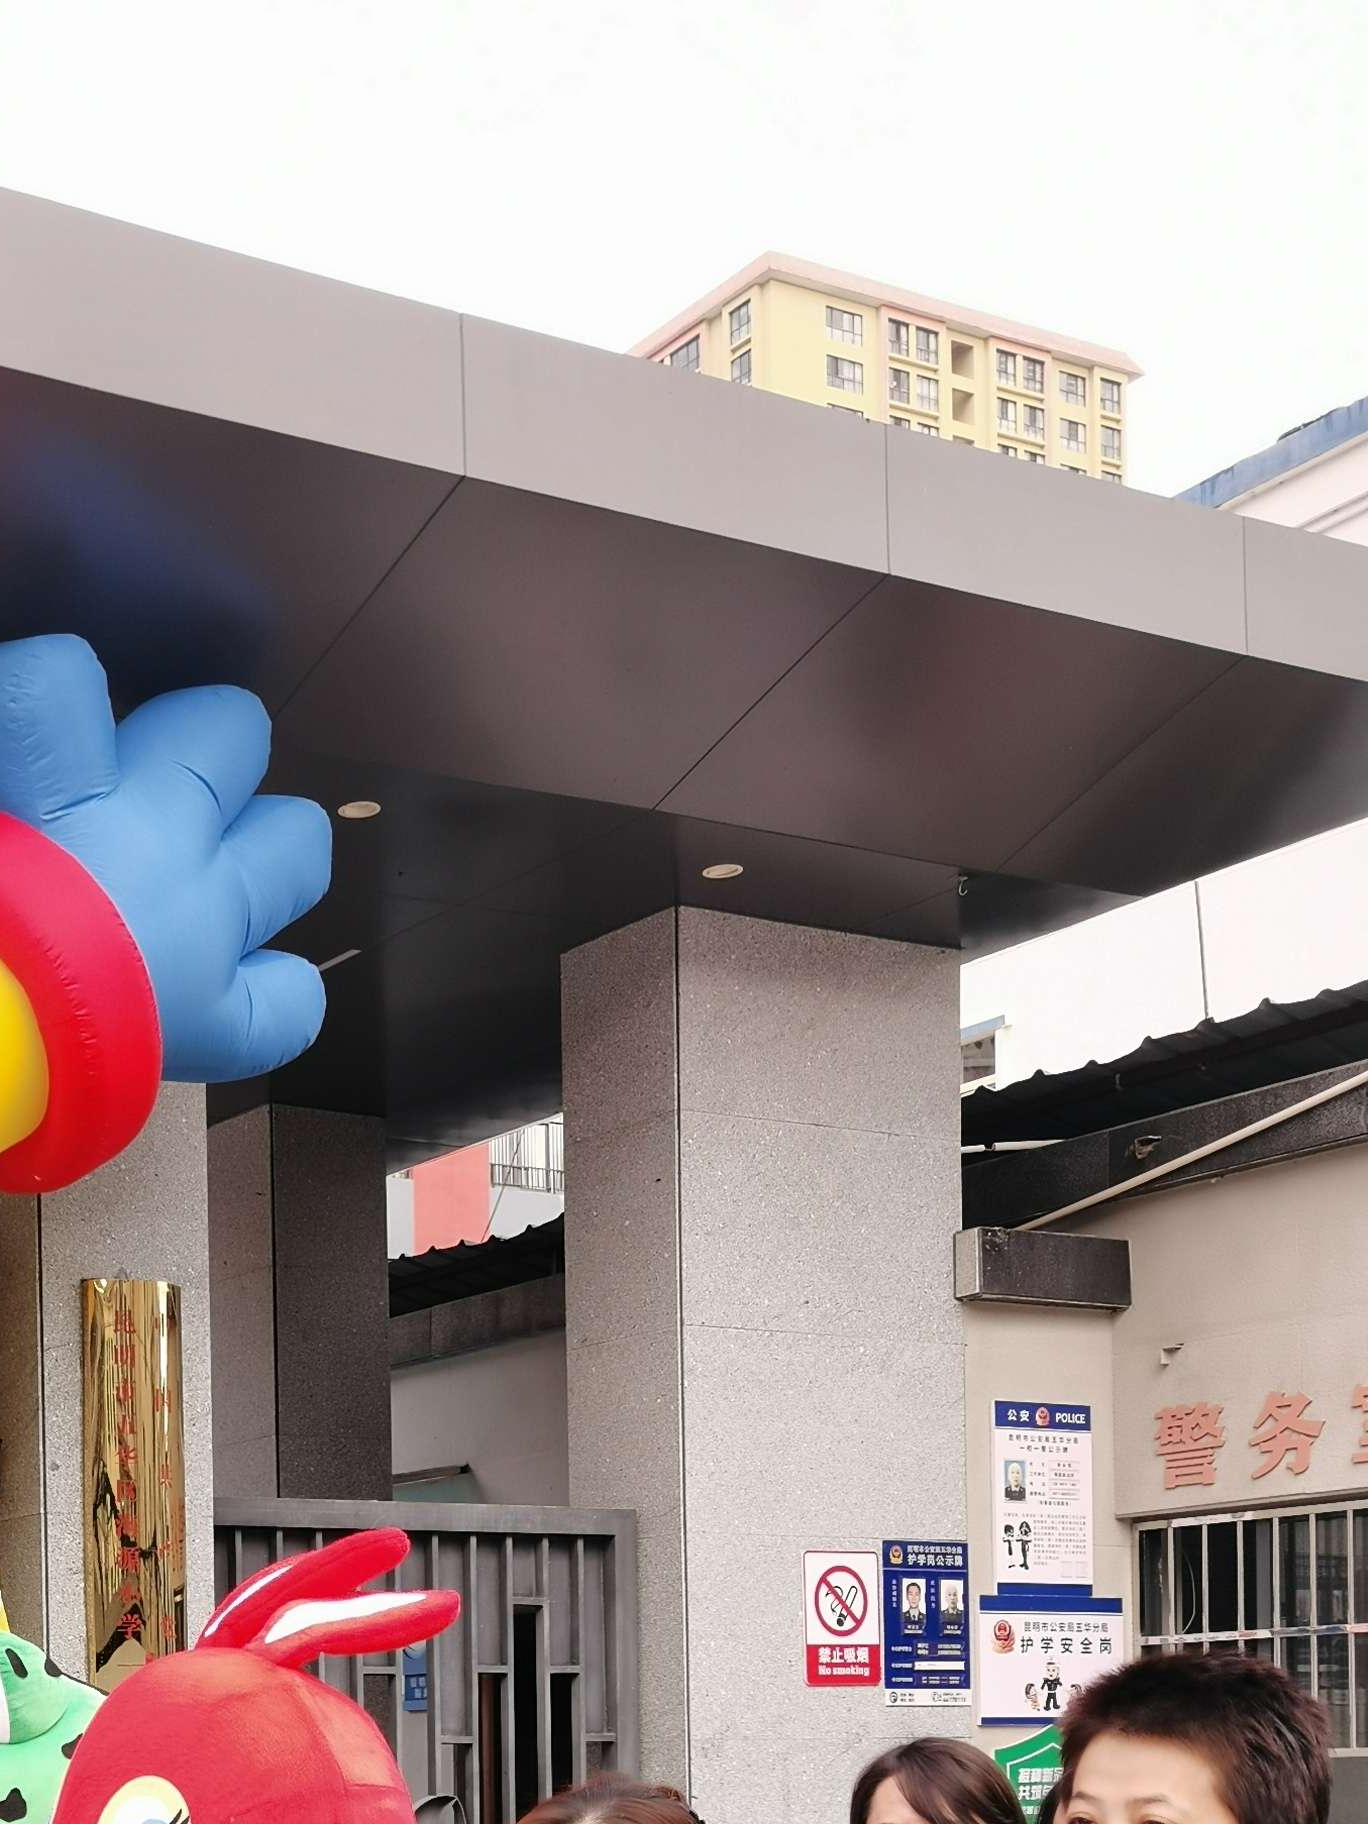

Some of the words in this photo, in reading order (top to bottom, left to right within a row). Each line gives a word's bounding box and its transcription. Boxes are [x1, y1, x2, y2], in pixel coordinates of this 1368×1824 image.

[1007, 1408, 1030, 1422] 公安
[1055, 1412, 1086, 1424] POLICE
[1154, 1384, 1368, 1489] 警务
[1024, 1621, 1109, 1633] 昆明市公安局五华分局
[1020, 1636, 1112, 1655] 护学安全岗
[818, 1646, 870, 1664] 禁止吸烟
[818, 1666, 831, 1675] No
[833, 1665, 870, 1677] smoking
